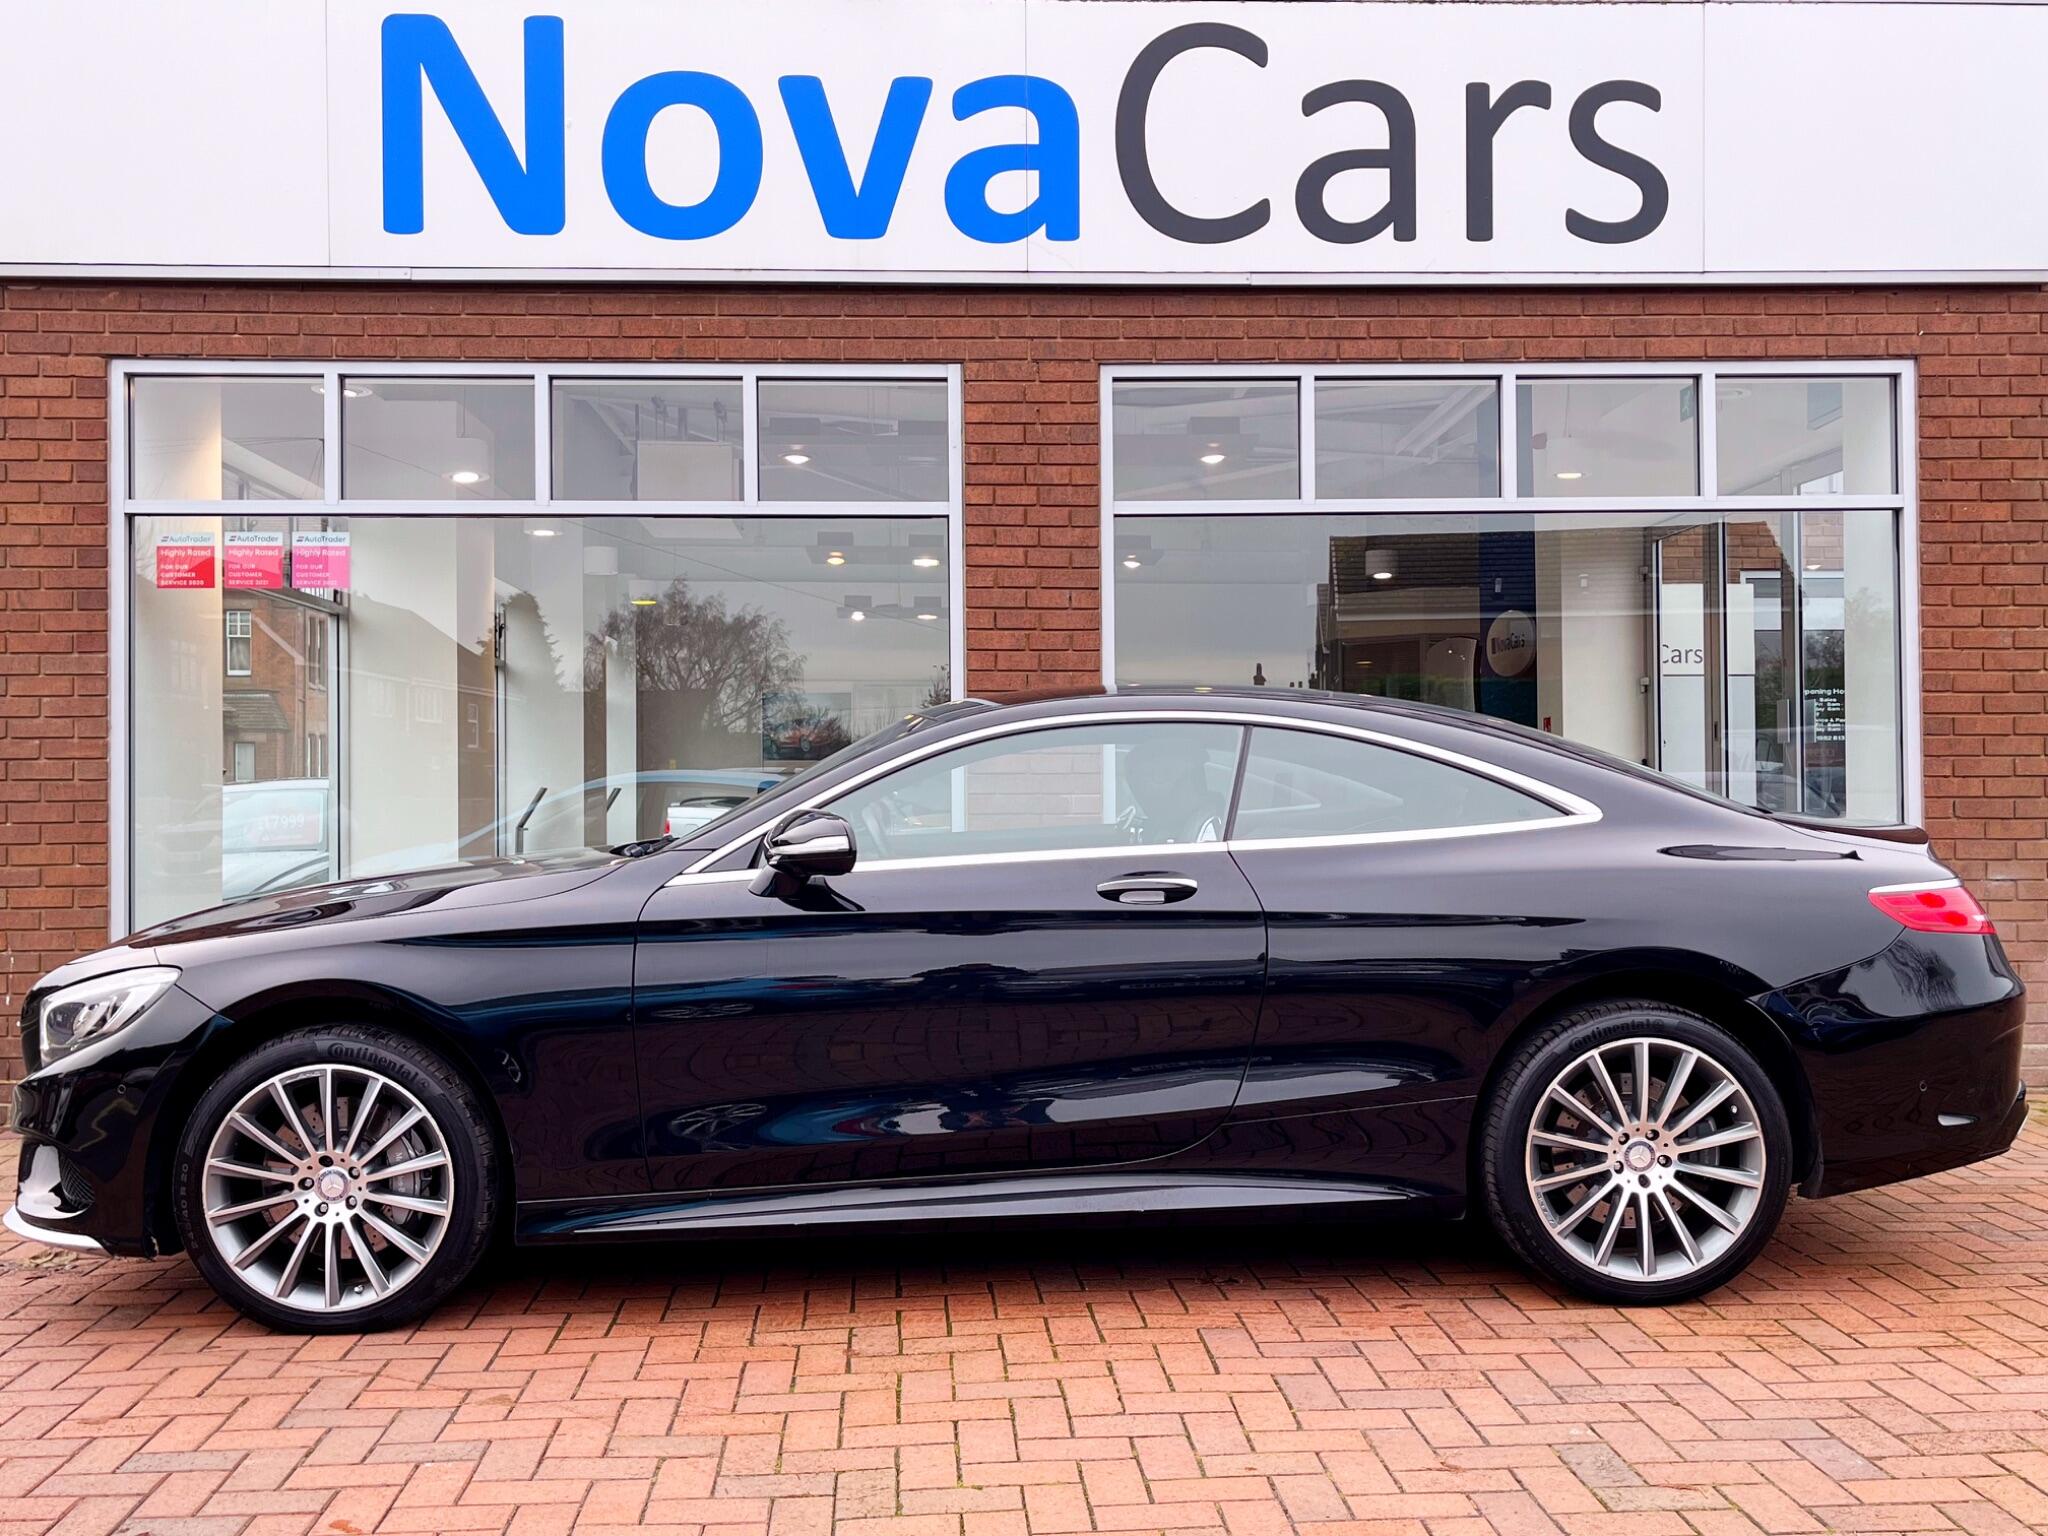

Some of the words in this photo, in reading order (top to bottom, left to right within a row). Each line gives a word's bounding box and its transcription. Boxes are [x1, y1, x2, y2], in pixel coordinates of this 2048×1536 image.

[382, 13, 1669, 245] NovaCars
[161, 549, 186, 557] Highly
[229, 549, 254, 557] Highly
[1804, 688, 1832, 696] pening
[327, 1042, 419, 1081] Continental
